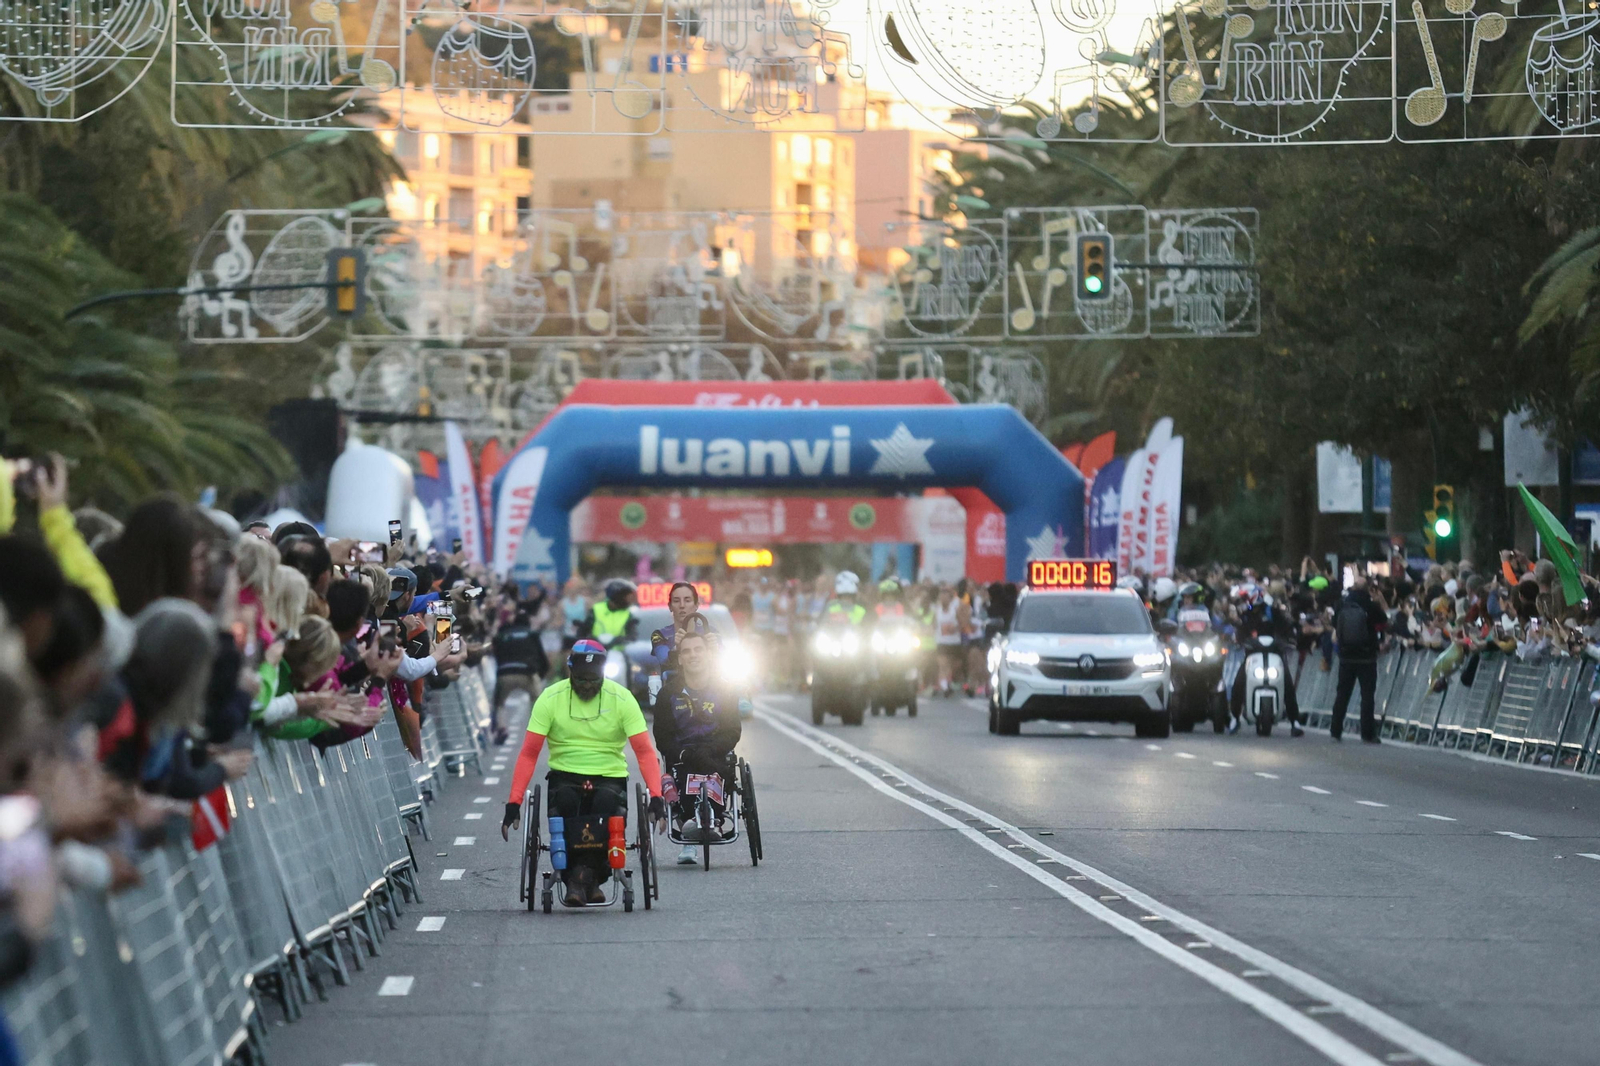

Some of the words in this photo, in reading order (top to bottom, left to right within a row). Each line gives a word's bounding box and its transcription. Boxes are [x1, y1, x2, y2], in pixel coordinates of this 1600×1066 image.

[1234, 40, 1324, 106] RIN
[640, 424, 851, 477] luanvi
[1032, 562, 1112, 585] 00:00:16
